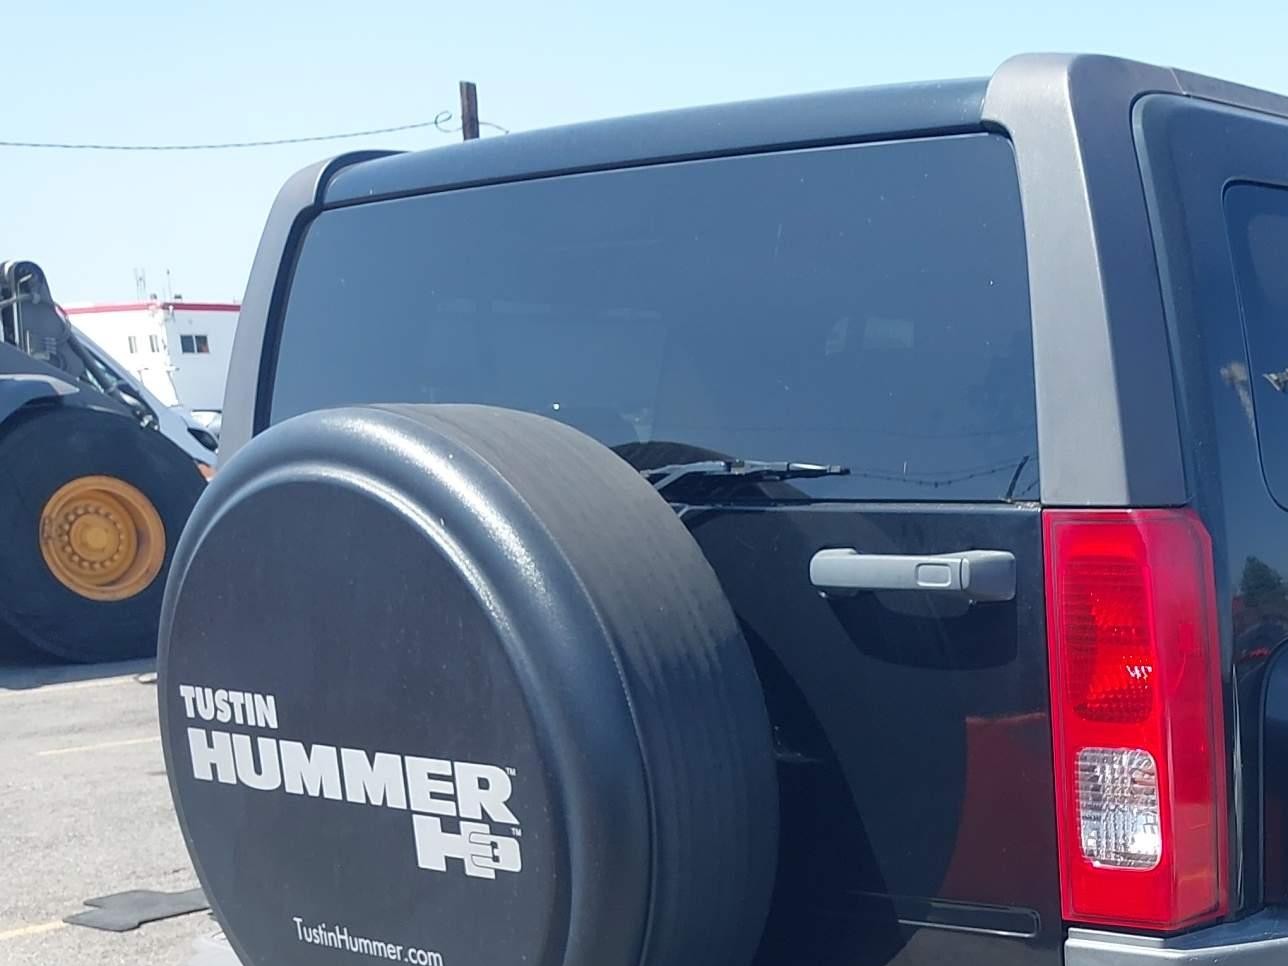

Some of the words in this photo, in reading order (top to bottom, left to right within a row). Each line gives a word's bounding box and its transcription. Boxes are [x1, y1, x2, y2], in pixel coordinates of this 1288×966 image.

[178, 683, 280, 730] TUSTIN
[187, 727, 521, 826] HUMMER
[412, 813, 523, 880] H3
